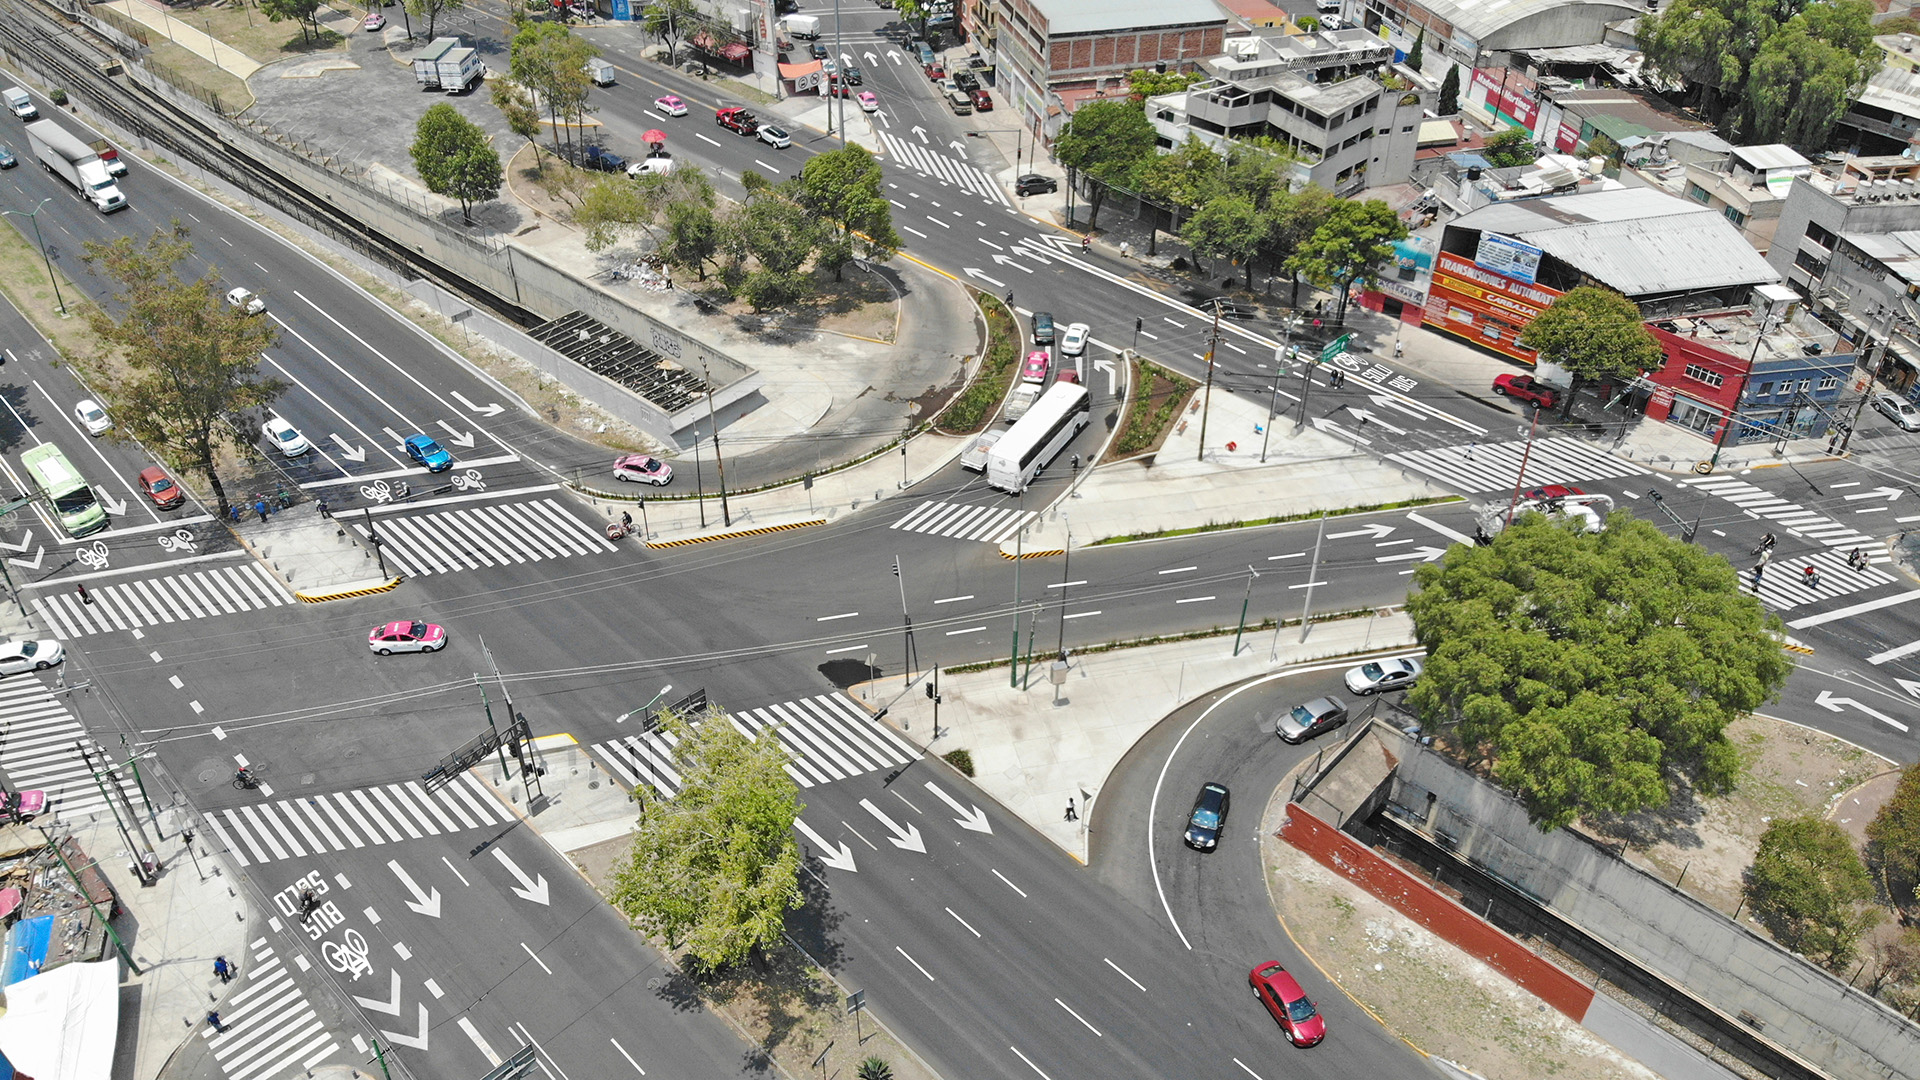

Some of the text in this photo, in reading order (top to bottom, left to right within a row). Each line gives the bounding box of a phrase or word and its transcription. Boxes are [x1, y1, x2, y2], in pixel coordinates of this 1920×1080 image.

[1440, 257, 1506, 290] TRANSMISIONES
[1486, 294, 1538, 317] CARBAJAL
[300, 900, 346, 941] BUS
